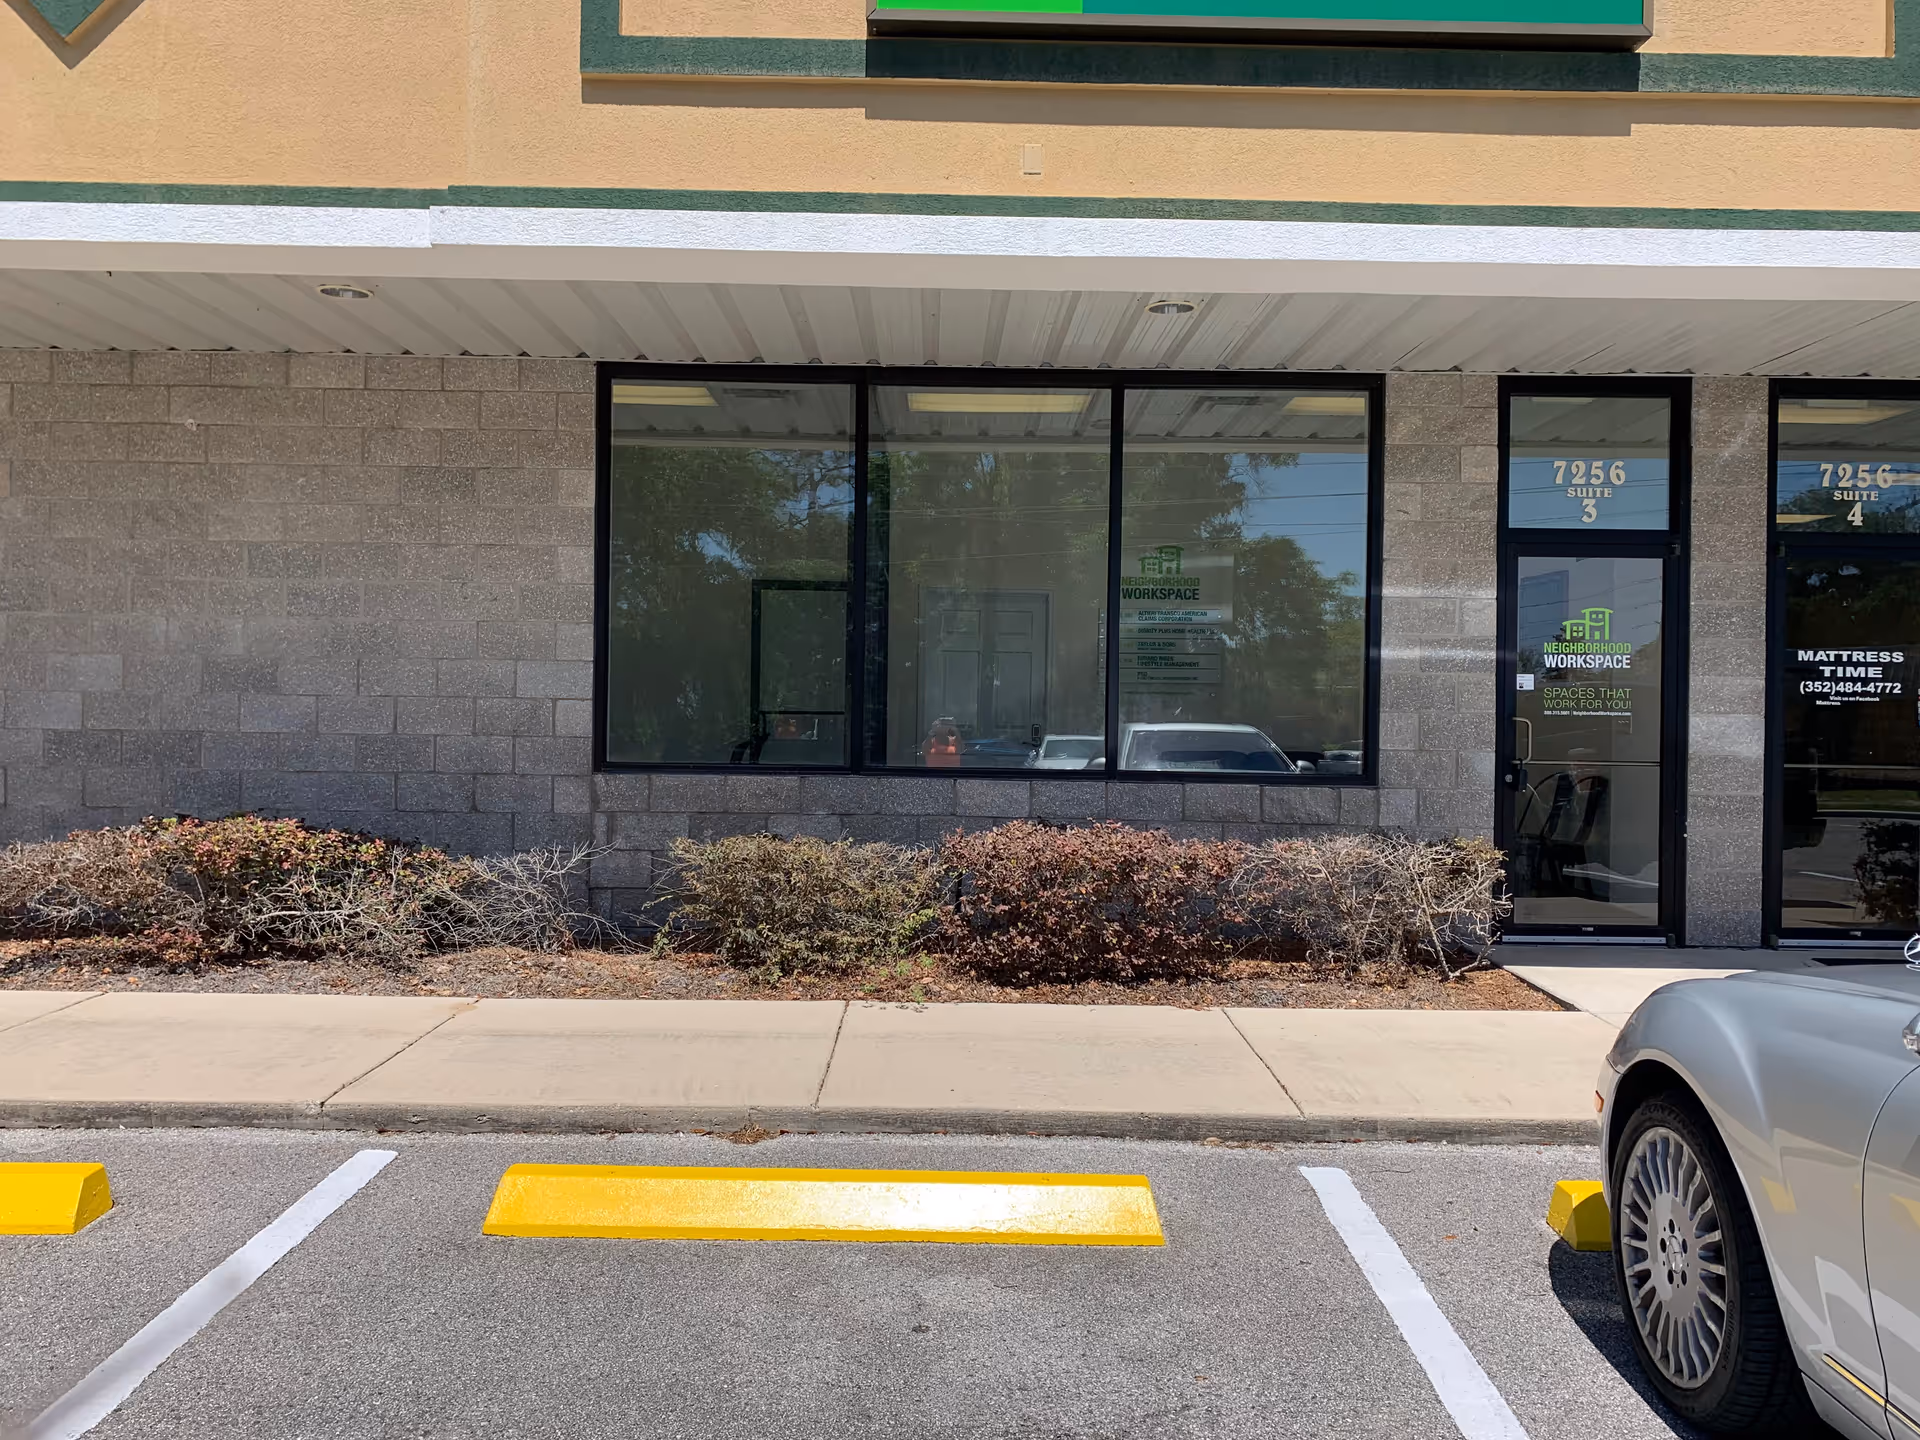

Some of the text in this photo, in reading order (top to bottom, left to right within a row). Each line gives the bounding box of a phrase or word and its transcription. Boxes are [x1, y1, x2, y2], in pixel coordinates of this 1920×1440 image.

[1553, 460, 1626, 485] 7256
[1820, 463, 1892, 489] 7256
[1567, 487, 1613, 498] SUITE
[1833, 490, 1879, 501] SUITE
[1581, 498, 1597, 523] 3
[1847, 502, 1864, 526] 4
[1121, 576, 1200, 587] NEIGHBORHOOD
[1121, 587, 1200, 600] WORKSPACE
[1544, 641, 1632, 654] NEIGHBORHOOD
[1544, 654, 1631, 669] WORKSPACE
[1798, 650, 1904, 663] MATTRESS
[1819, 665, 1883, 678] TIME
[1544, 687, 1632, 699] SPACES THAT
[1799, 681, 1902, 695] (352)484-4772
[1544, 699, 1632, 709] WORK FOR YOU!
